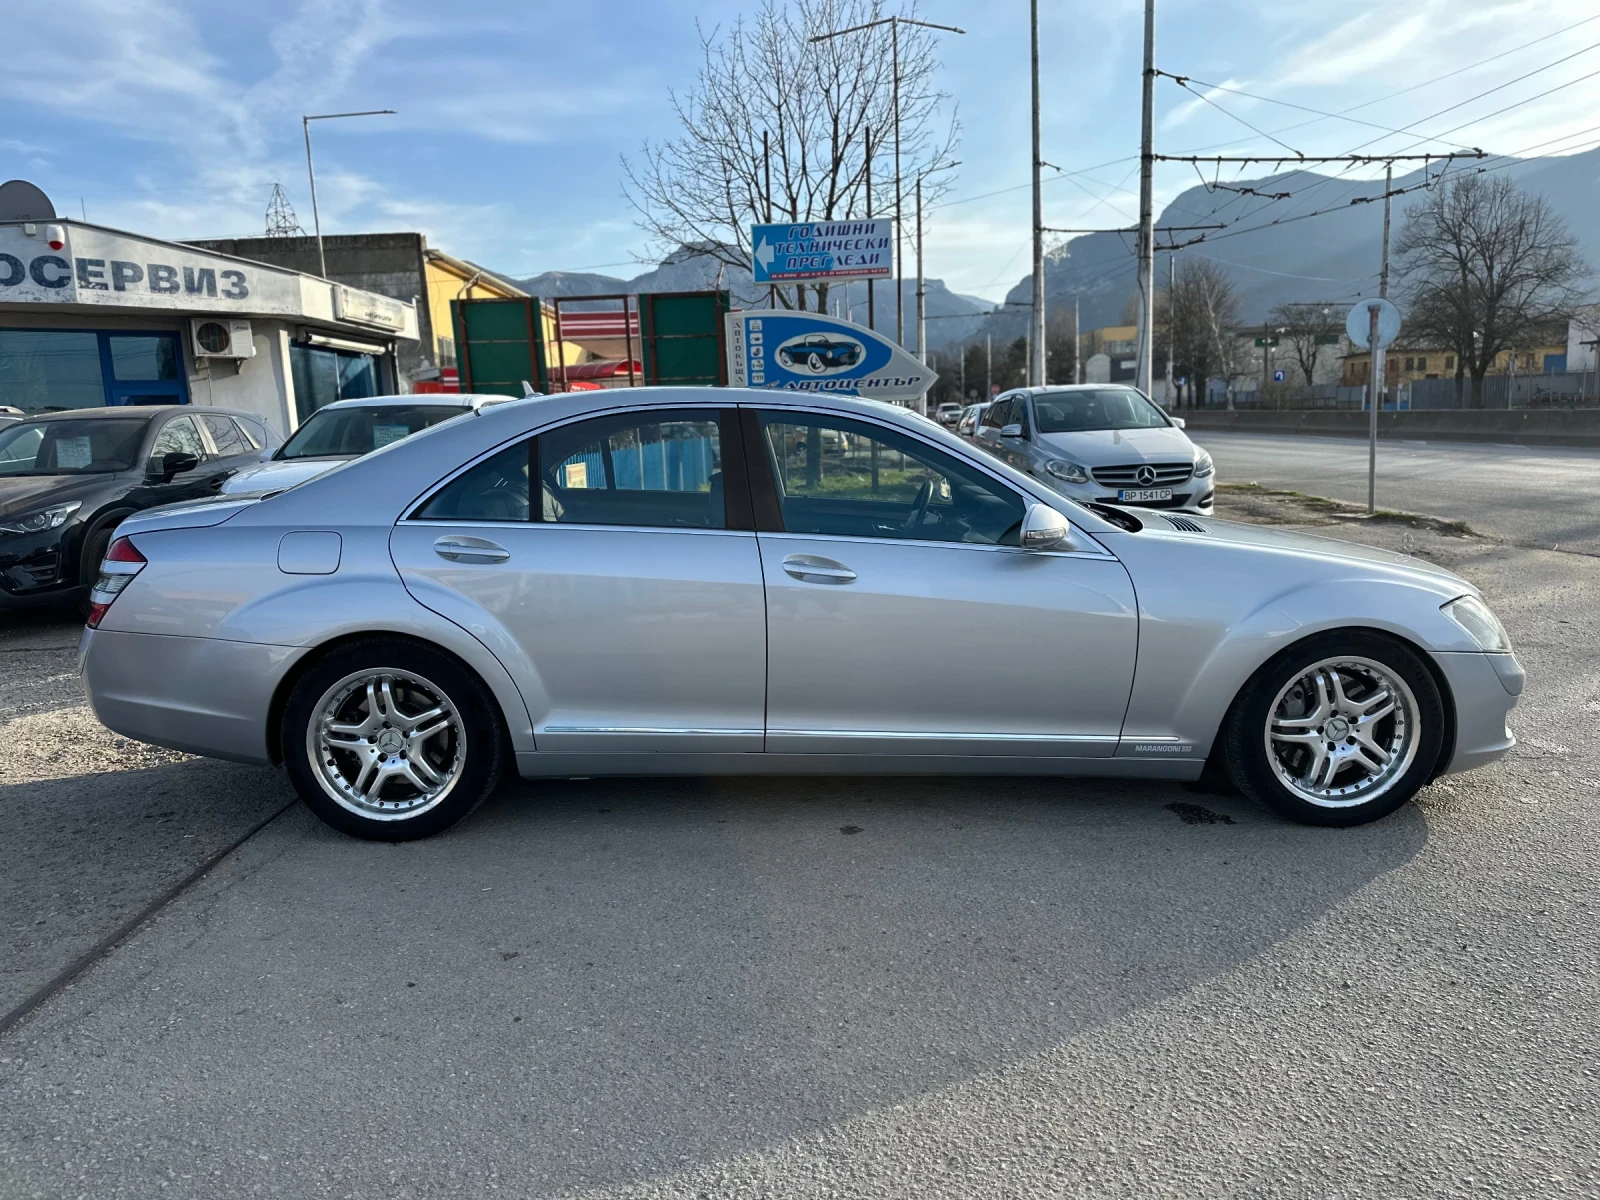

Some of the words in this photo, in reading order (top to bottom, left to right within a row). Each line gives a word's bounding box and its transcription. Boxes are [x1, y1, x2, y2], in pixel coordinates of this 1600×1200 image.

[788, 223, 876, 240] ГОДИШНИ
[776, 238, 889, 255] ТЕХНИЧЕСКИ
[786, 253, 880, 270] ПРЕГЛЕДИ
[784, 376, 920, 391] АВТОЦЕНТЪР
[1124, 492, 1136, 500] BP
[1139, 491, 1158, 499] 1541
[1160, 490, 1170, 499] CP
